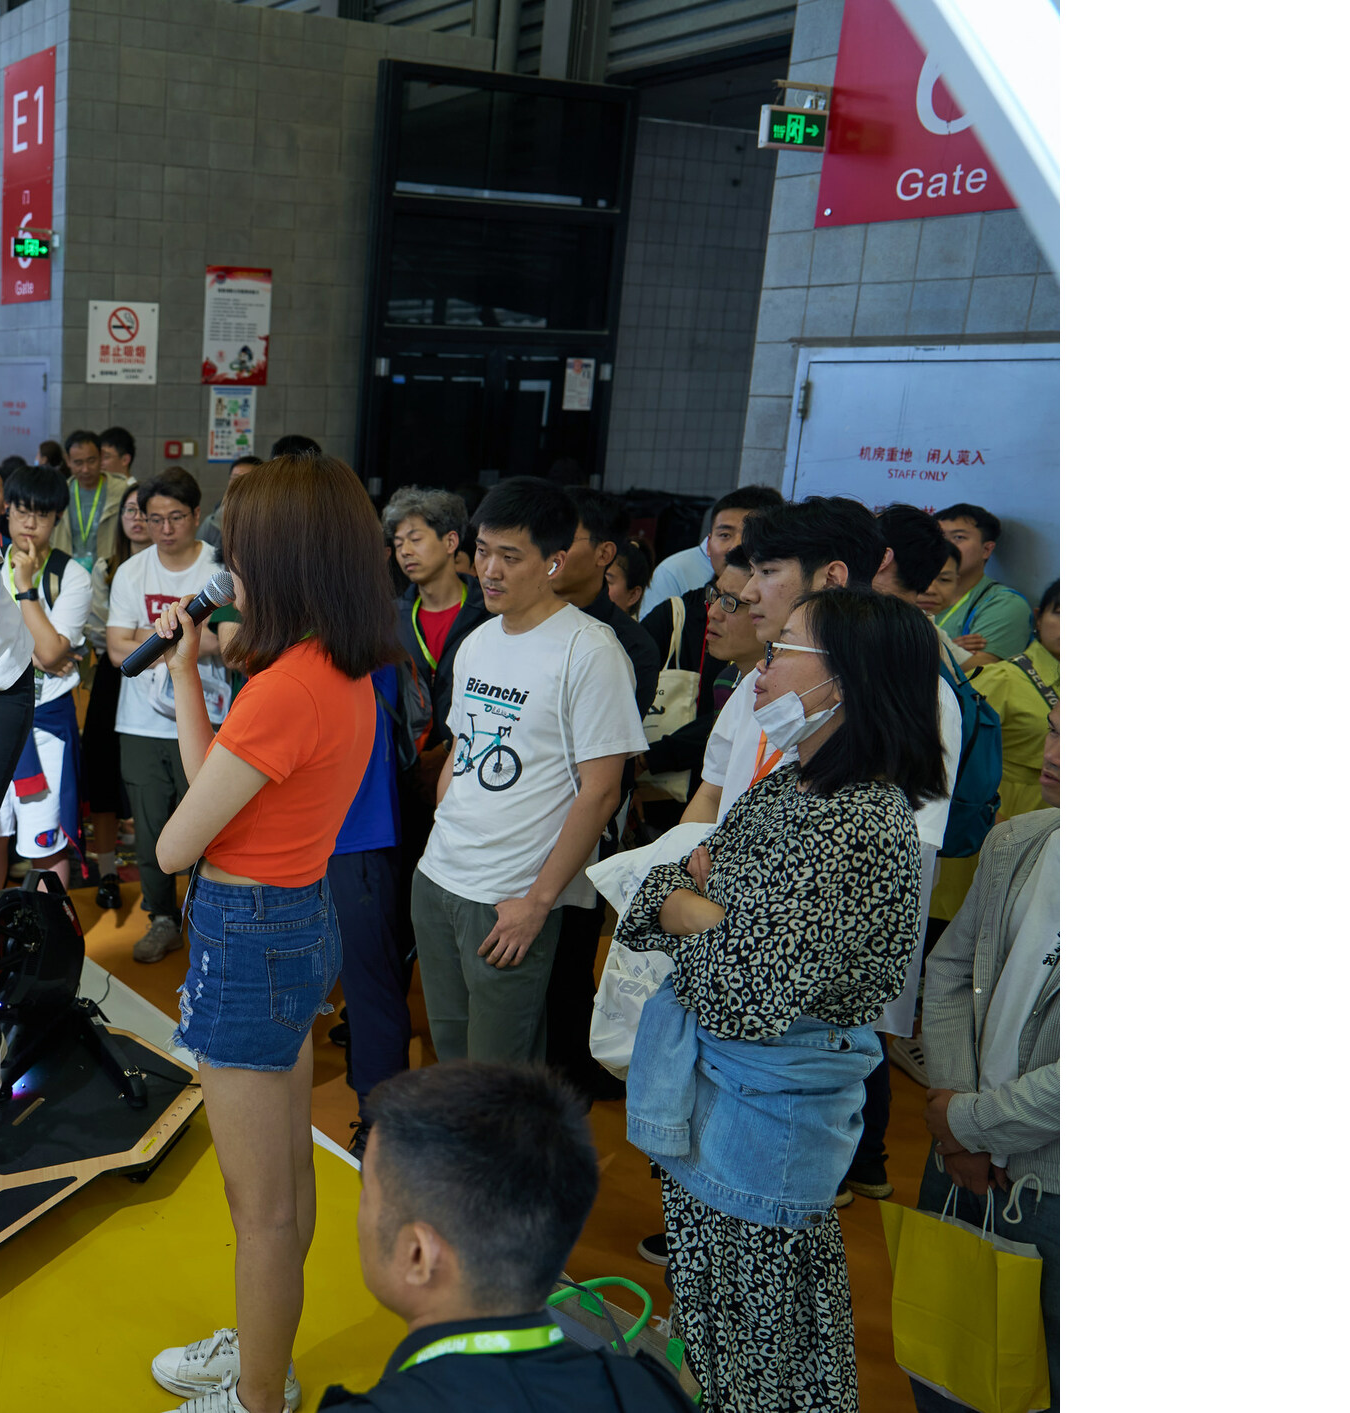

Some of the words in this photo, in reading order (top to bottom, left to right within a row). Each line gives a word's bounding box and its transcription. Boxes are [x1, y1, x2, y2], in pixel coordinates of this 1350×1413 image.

[12, 85, 45, 154] E1
[895, 164, 988, 201] Gate
[15, 280, 34, 296] Gate
[99, 344, 147, 358] 禁止吸烟
[858, 446, 913, 463] 机房重地
[887, 468, 917, 479] STAFF
[919, 470, 949, 482] ONLY
[465, 677, 530, 705] Bianchi
[1045, 690, 1059, 709] YO
